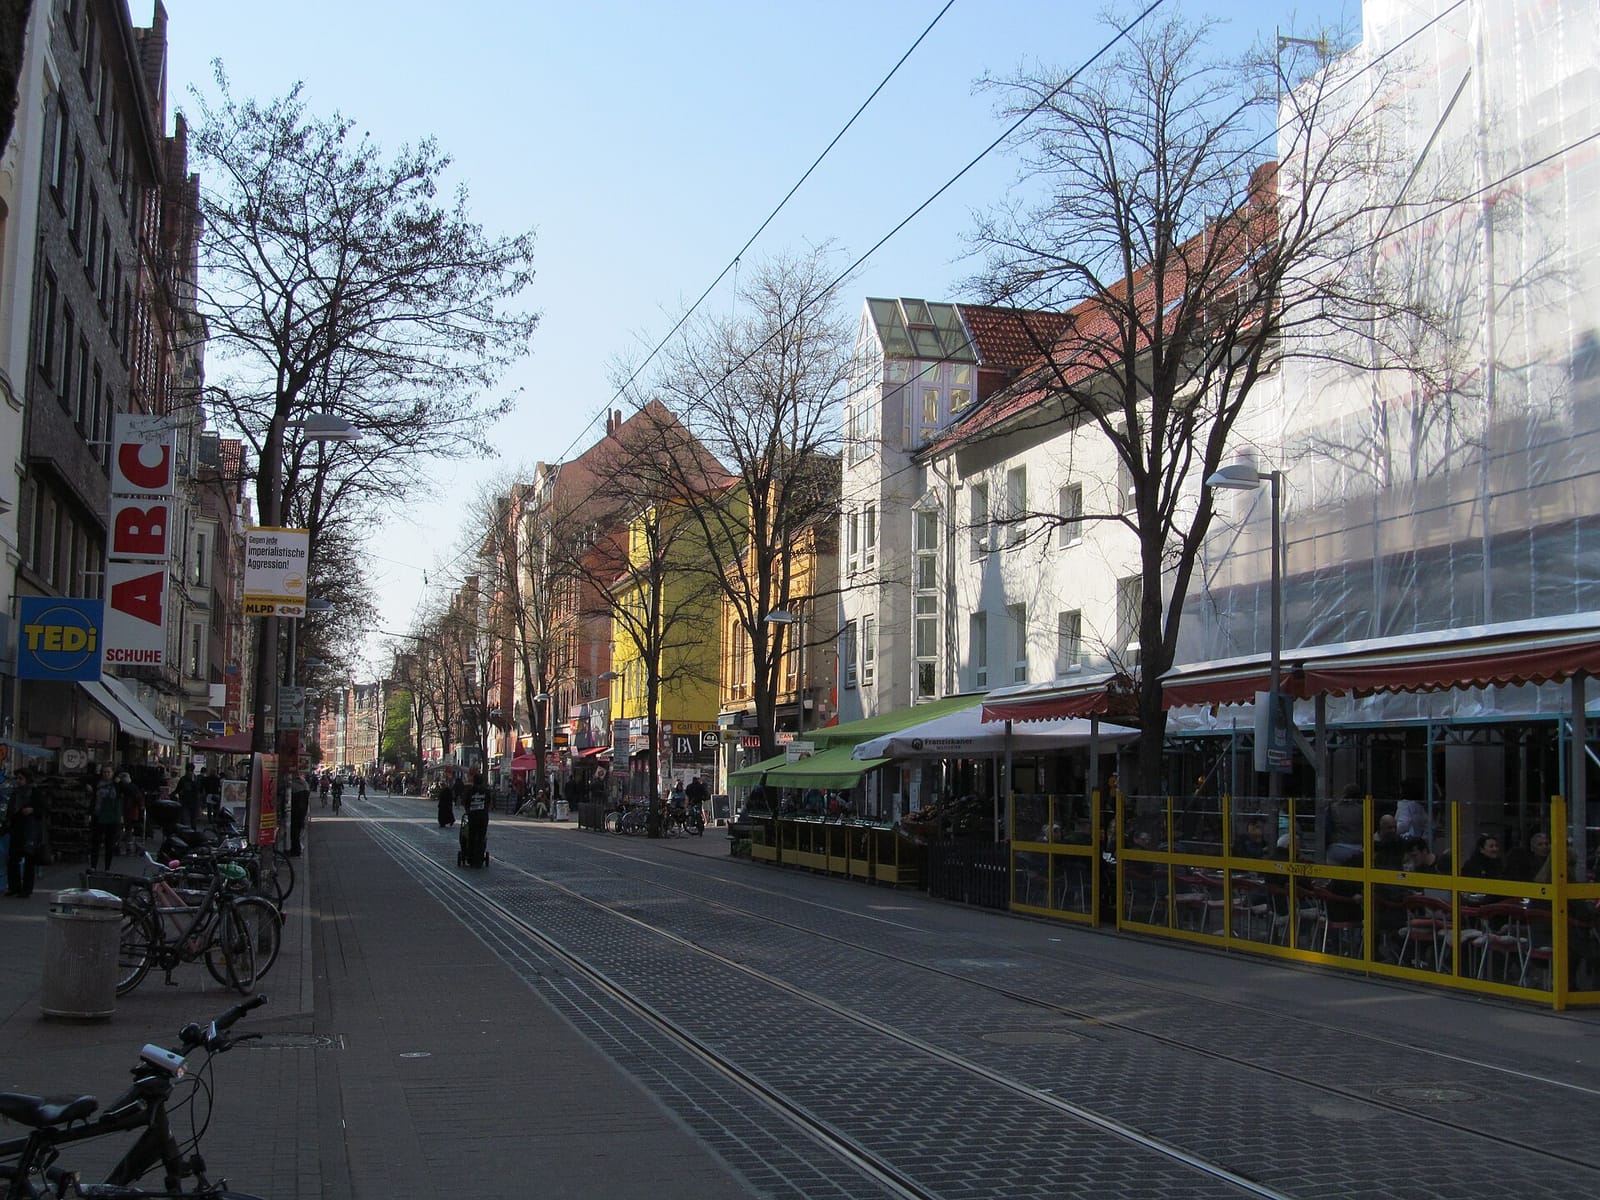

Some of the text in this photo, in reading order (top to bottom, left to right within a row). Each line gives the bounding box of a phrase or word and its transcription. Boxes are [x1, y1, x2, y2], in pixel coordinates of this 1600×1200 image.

[111, 443, 171, 627] ABC
[249, 536, 265, 544] Gegen
[248, 547, 305, 558] imperialistische
[248, 559, 289, 569] Aggression!
[246, 604, 275, 613] MLPD
[24, 625, 96, 652] TEDi
[106, 649, 161, 663] SCHUHE
